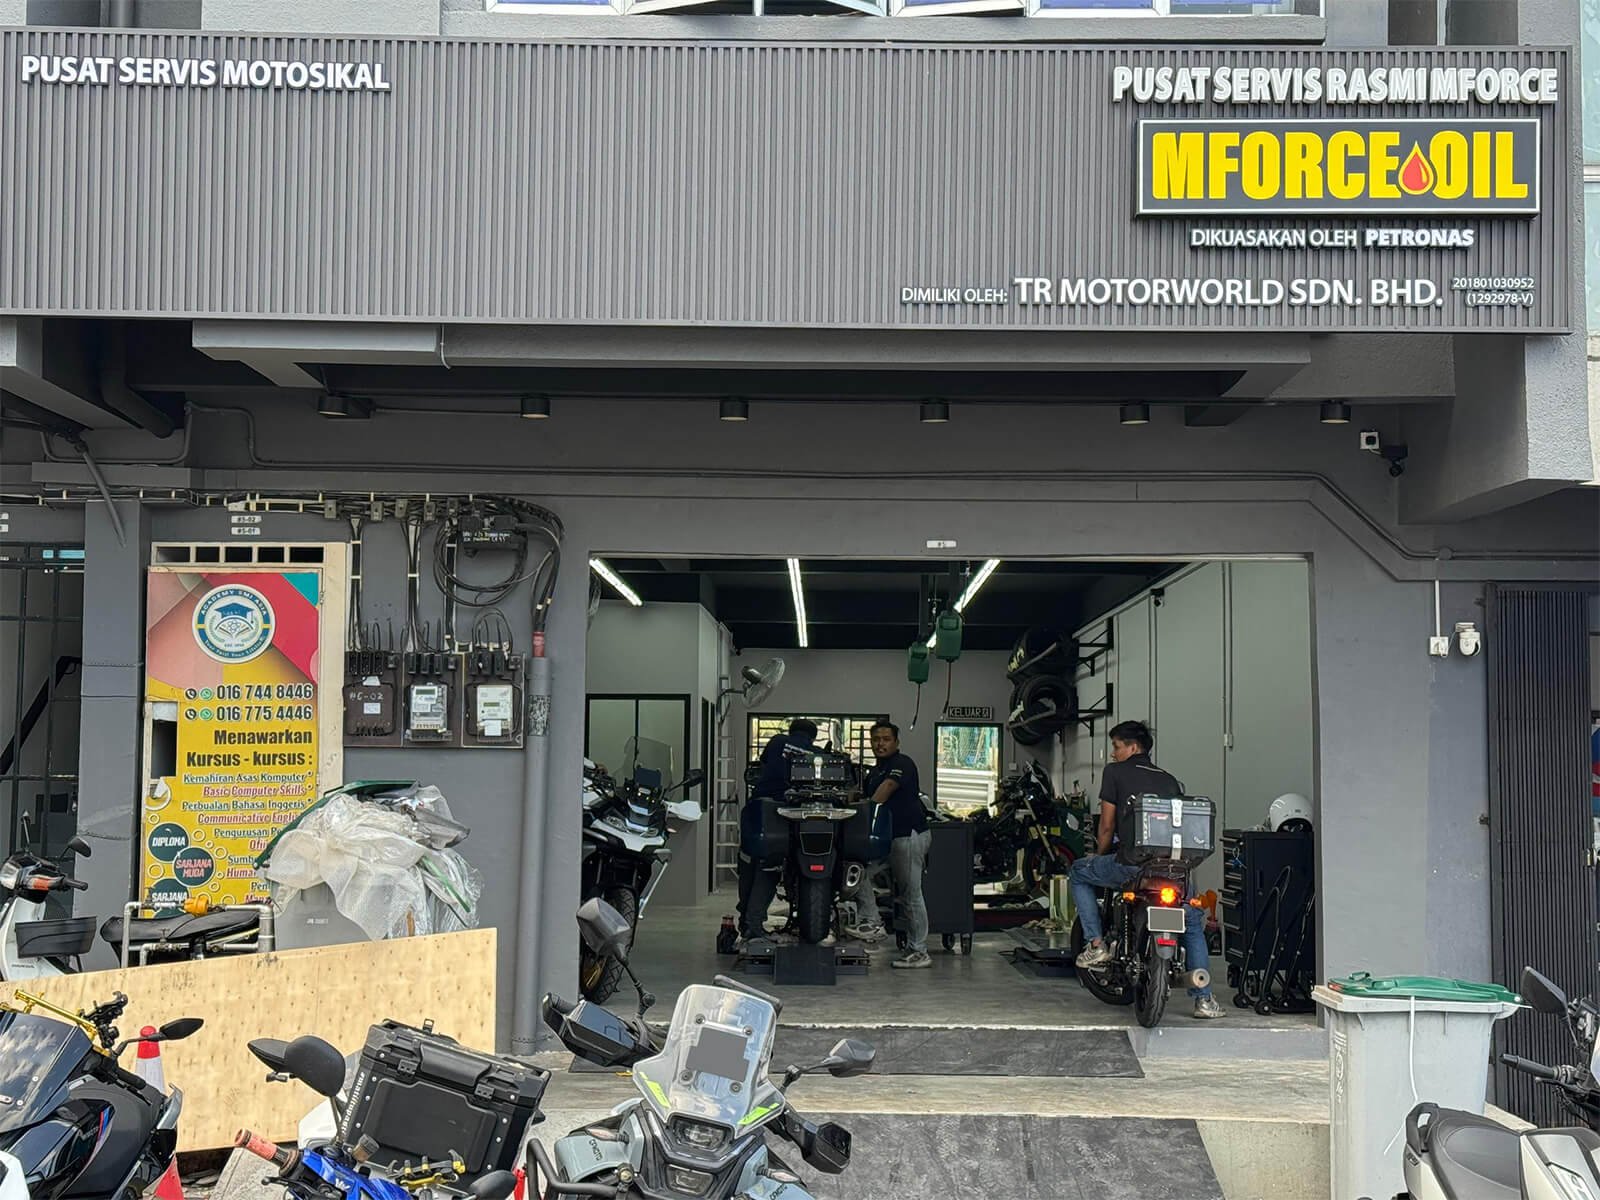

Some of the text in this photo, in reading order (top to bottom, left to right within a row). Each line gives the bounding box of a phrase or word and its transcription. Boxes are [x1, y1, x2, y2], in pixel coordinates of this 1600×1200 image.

[22, 55, 391, 91] PUSAT SERVIS MOTOSIKAL
[1112, 66, 1559, 104] PUSAT SERVIS RASMI MFORCE
[1152, 131, 1528, 200] MFORCE OIL
[1191, 228, 1475, 249] DIKUASAKAN OLEH PETRONAS
[1453, 277, 1535, 289] 201801030952
[902, 277, 1443, 306] DIMILIKI OLEH: TR MOTORWORLD SDN. BHD.
[1465, 291, 1535, 306] (1292978-V)
[217, 685, 313, 700] 016 744 8446
[217, 706, 313, 721] 016 775 4446
[949, 707, 982, 717] KELUAR
[214, 729, 313, 746] Menawarkan
[187, 752, 241, 767] Kursus
[253, 752, 306, 767] kursus
[184, 773, 306, 784] Kemahiran Asas Komputer
[203, 785, 306, 798] Basic Computer Skills
[182, 800, 305, 811] Perbualan Bahasa Inggeris
[198, 813, 271, 824] Communicative
[214, 828, 269, 839] Pengurusan
[152, 837, 186, 847] DIPLOMA
[176, 860, 212, 869] SARJANA
[183, 869, 205, 878] MUDA
[152, 892, 187, 902] SARJANA
